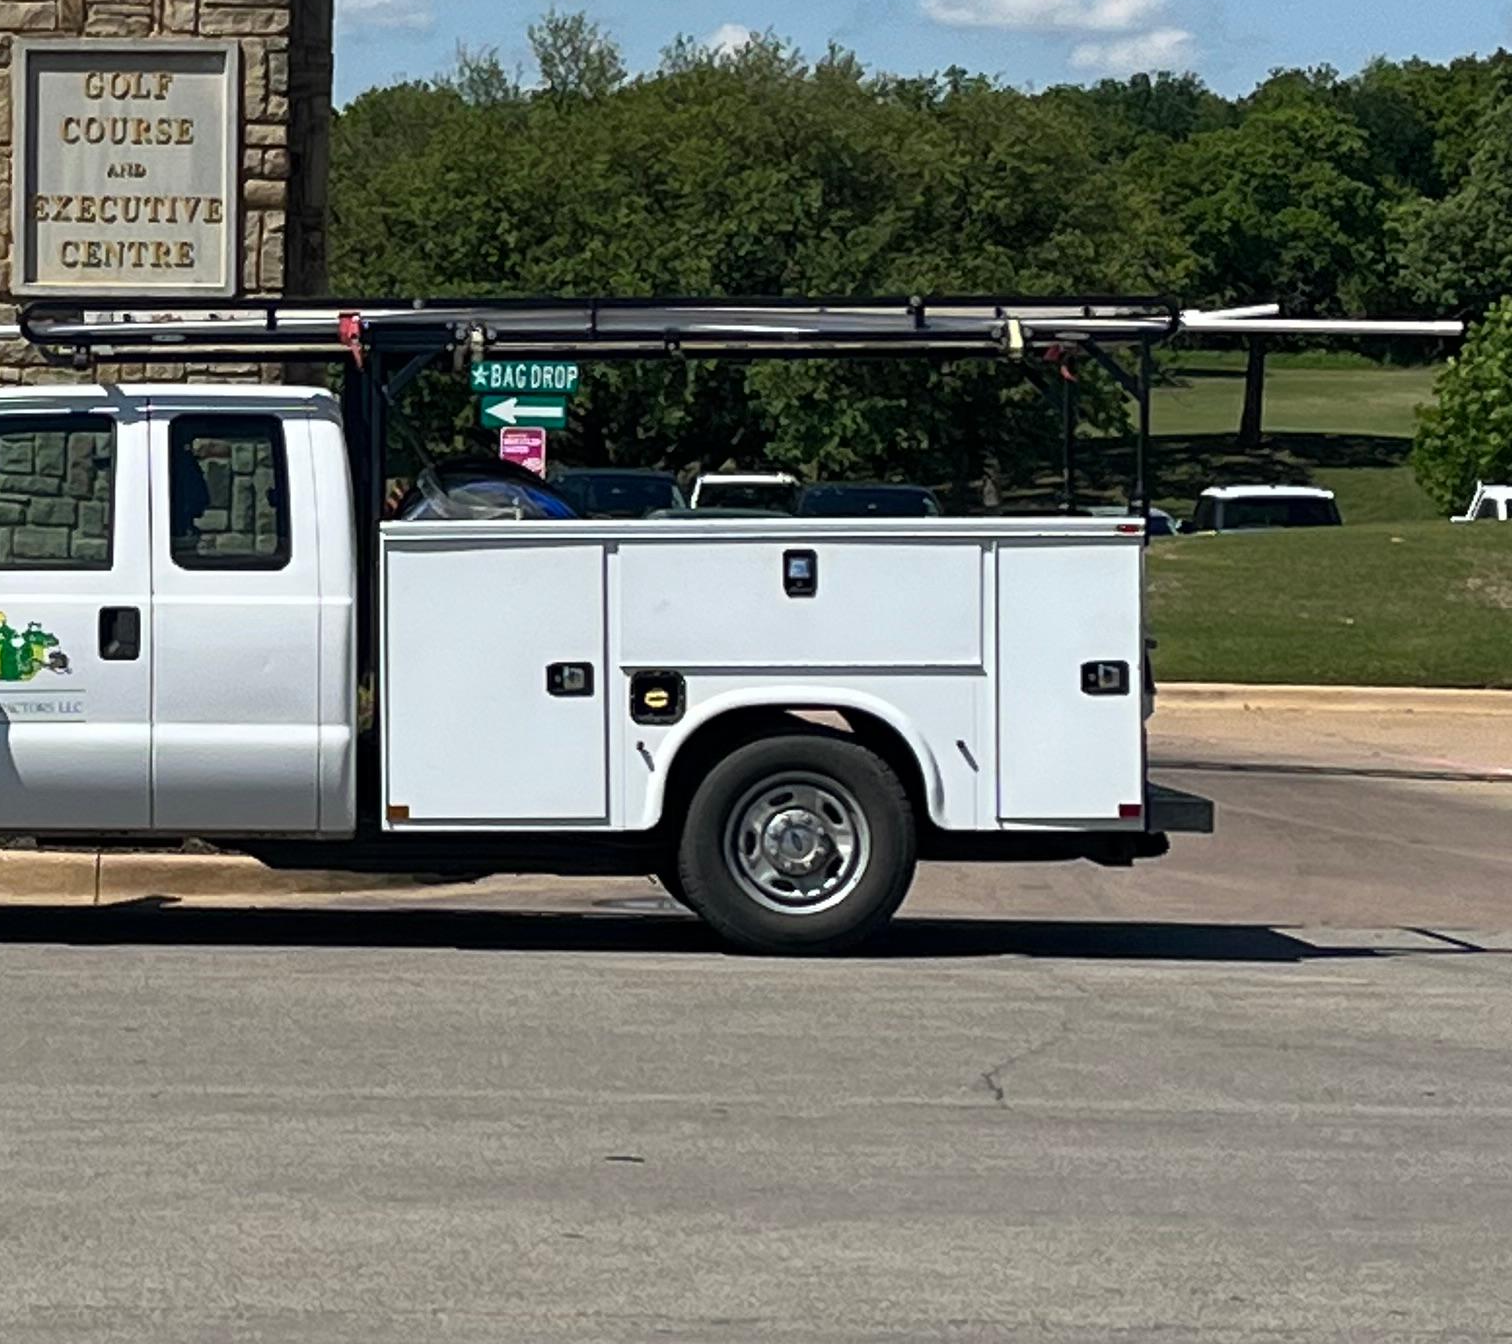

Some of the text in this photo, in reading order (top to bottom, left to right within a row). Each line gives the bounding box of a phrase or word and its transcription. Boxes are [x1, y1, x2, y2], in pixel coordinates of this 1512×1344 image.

[85, 71, 174, 100] GOLF
[62, 117, 195, 145] COURSE
[106, 162, 147, 179] AND
[34, 196, 223, 224] EXECUTIVE
[61, 241, 195, 268] CENTRE
[490, 364, 578, 389] BAG DROP
[58, 701, 83, 714] LLC
